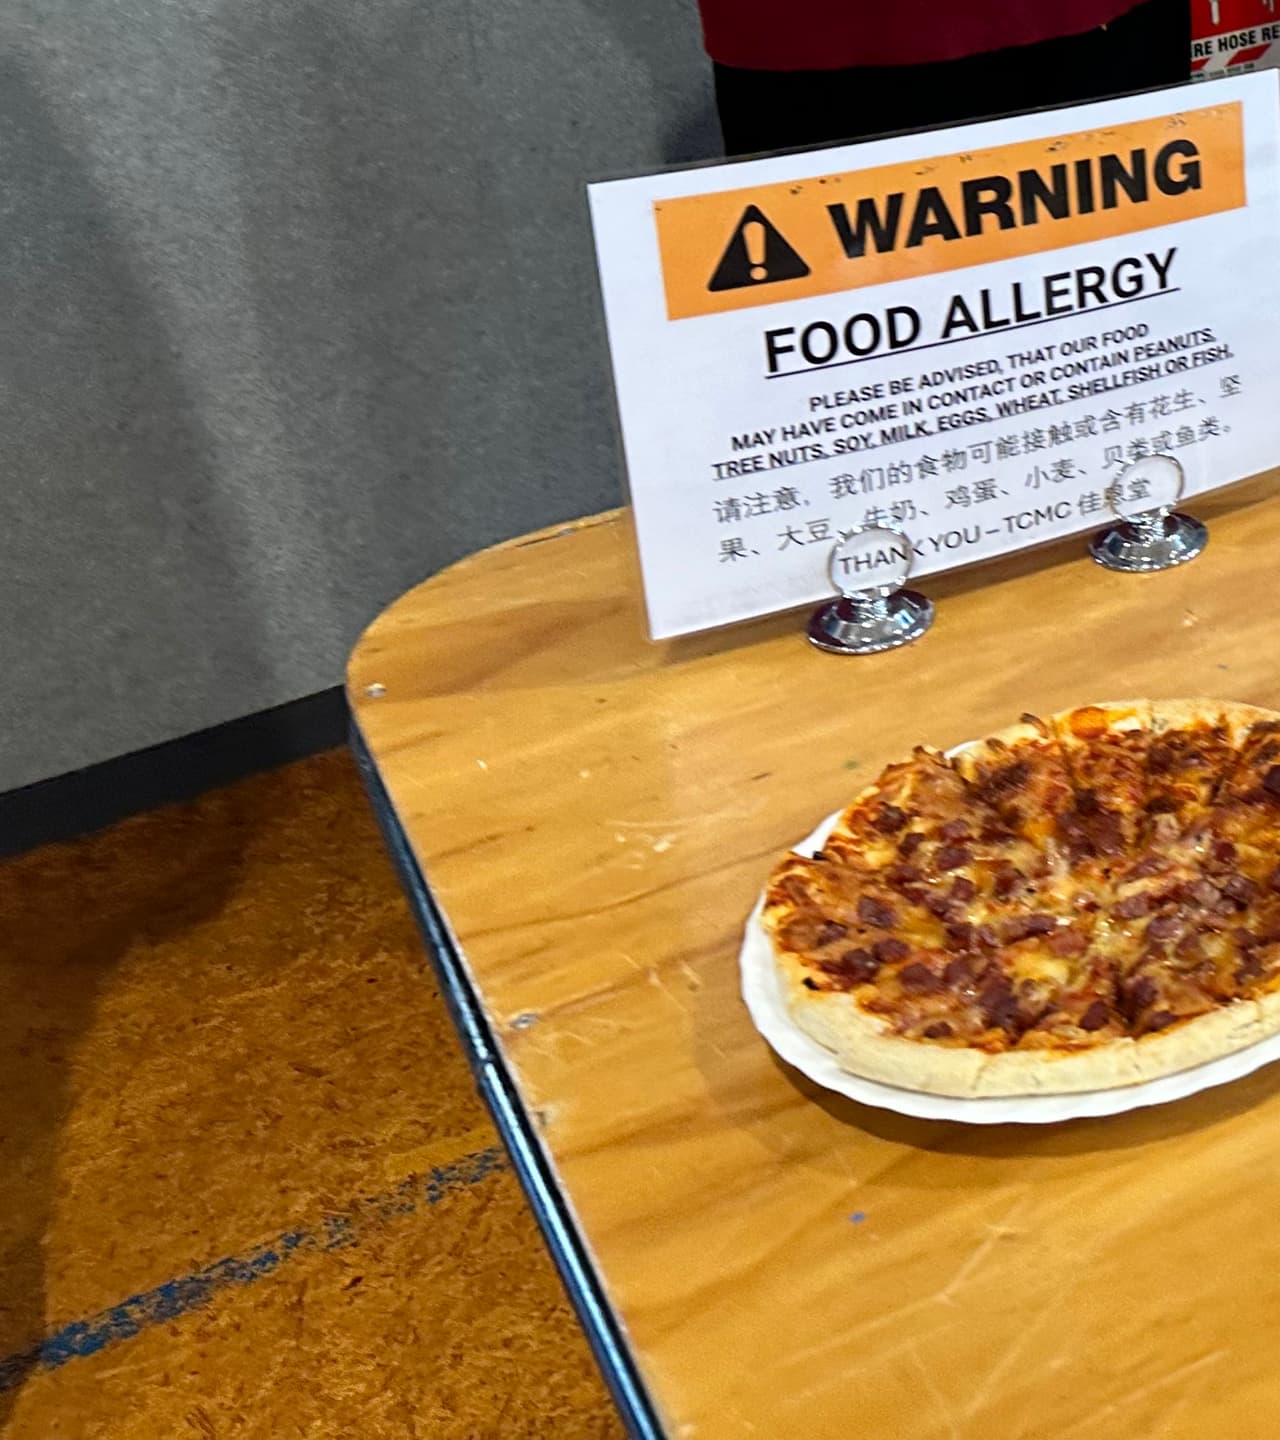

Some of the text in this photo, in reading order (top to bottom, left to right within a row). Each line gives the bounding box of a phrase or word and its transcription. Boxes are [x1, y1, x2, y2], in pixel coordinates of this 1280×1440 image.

[1190, 40, 1213, 58] RE
[1217, 30, 1257, 52] HOSE
[826, 138, 1204, 260] WARNING
[764, 247, 1179, 374] FOOD ALLERGY
[809, 323, 1149, 412] PLEASE BE ADVISED, THAT OUR FOOD
[711, 344, 1235, 479] TREE NUTS, SOY, MILK, EGGS, WHEAT, SHELLFISH OR FISH.
[731, 328, 1216, 451] MAY HAVE COME IN CONTACT OR CONTAIN PEANUTS,
[838, 538, 925, 575] THANK
[928, 524, 981, 553] YOU
[1003, 501, 1073, 533] TCMC
